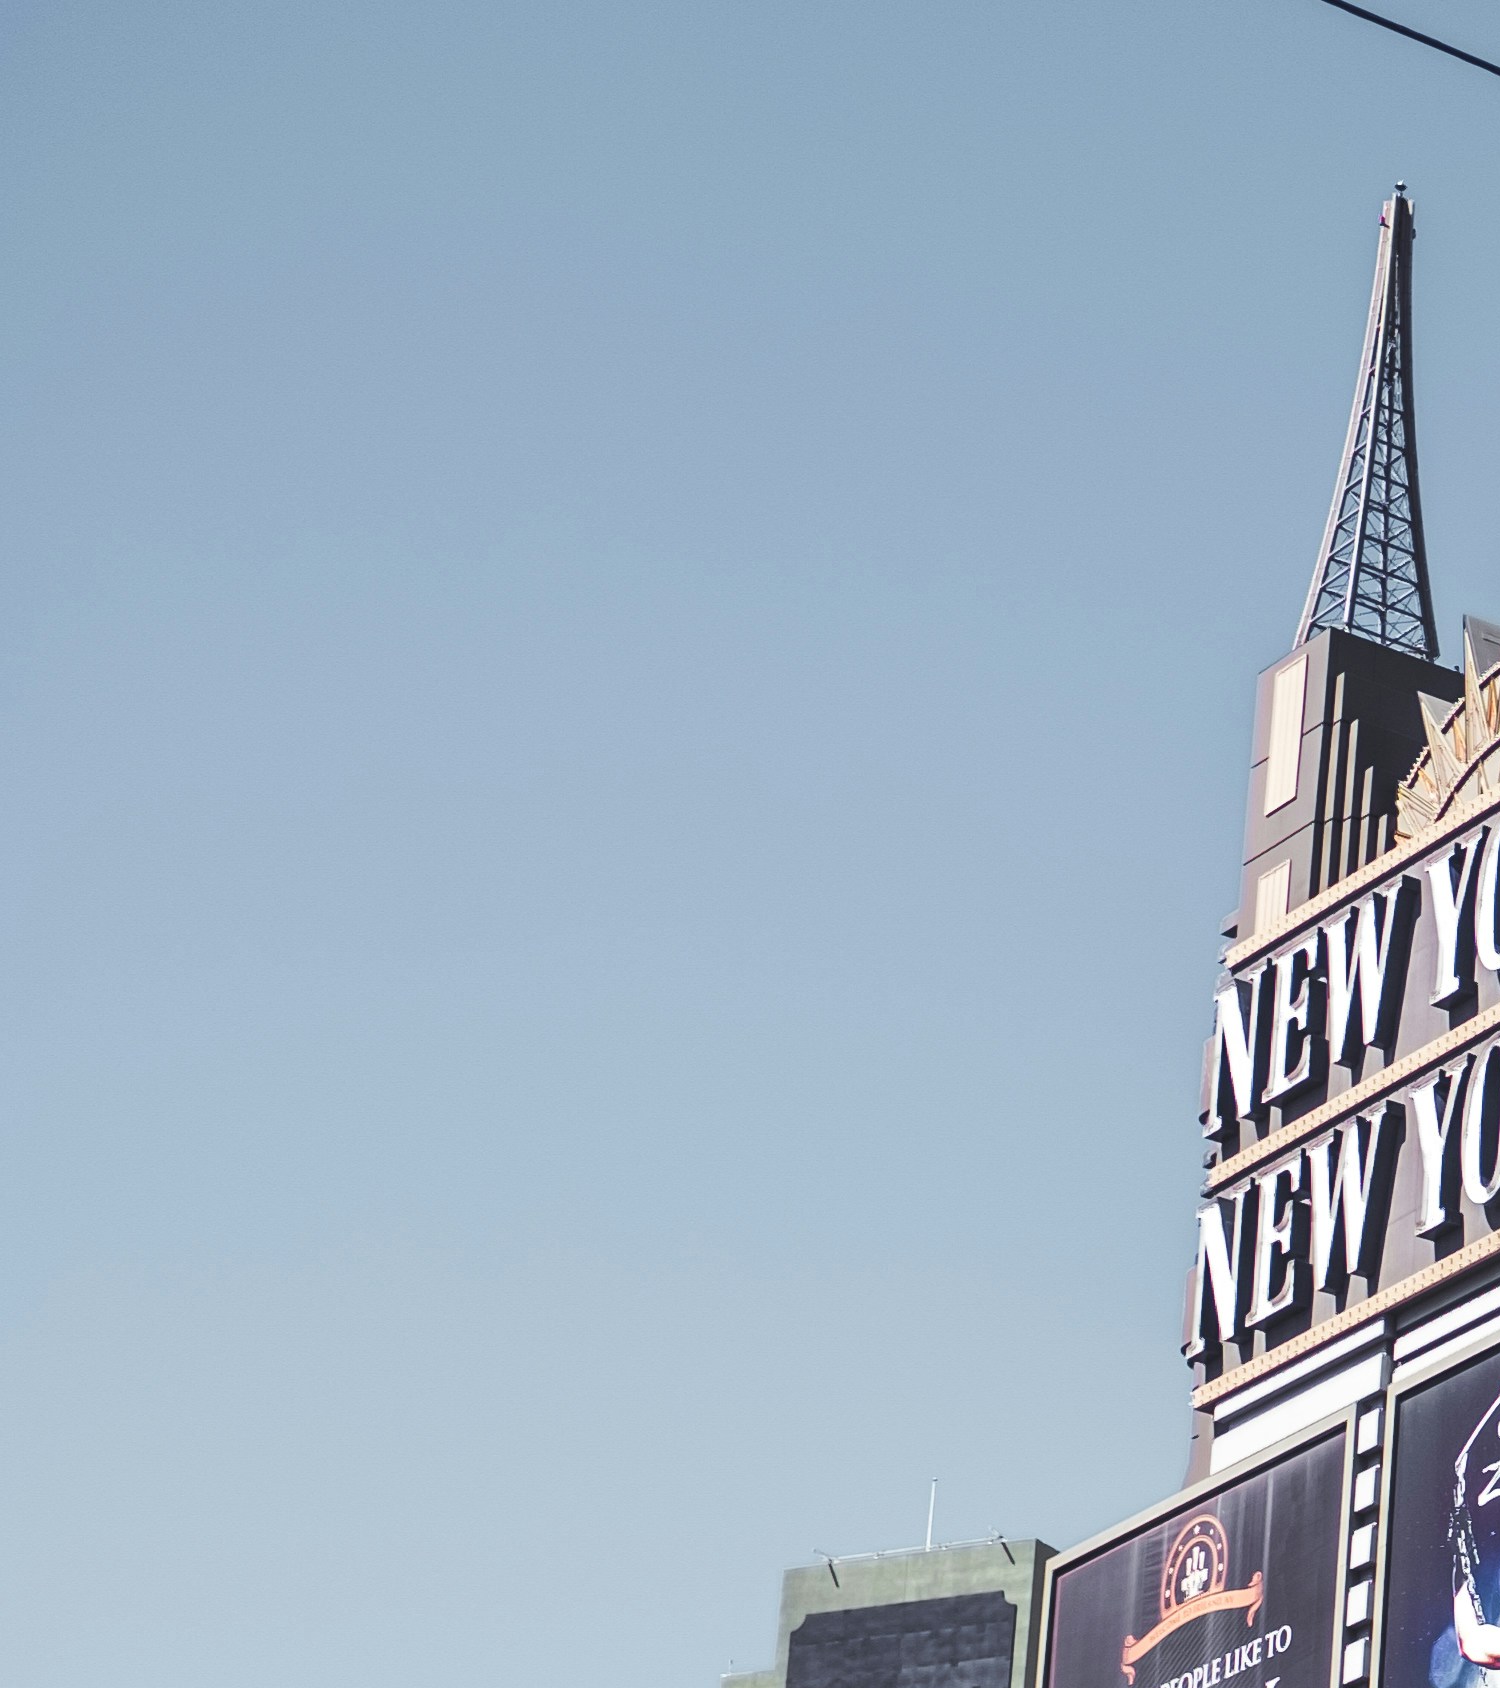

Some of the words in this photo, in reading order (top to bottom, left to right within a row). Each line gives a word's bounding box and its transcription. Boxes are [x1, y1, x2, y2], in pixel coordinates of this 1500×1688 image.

[1203, 884, 1404, 1141] NEW
[1186, 1106, 1392, 1358] NEW
[1223, 1637, 1263, 1679] LIKE
[1265, 1624, 1293, 1659] TO
